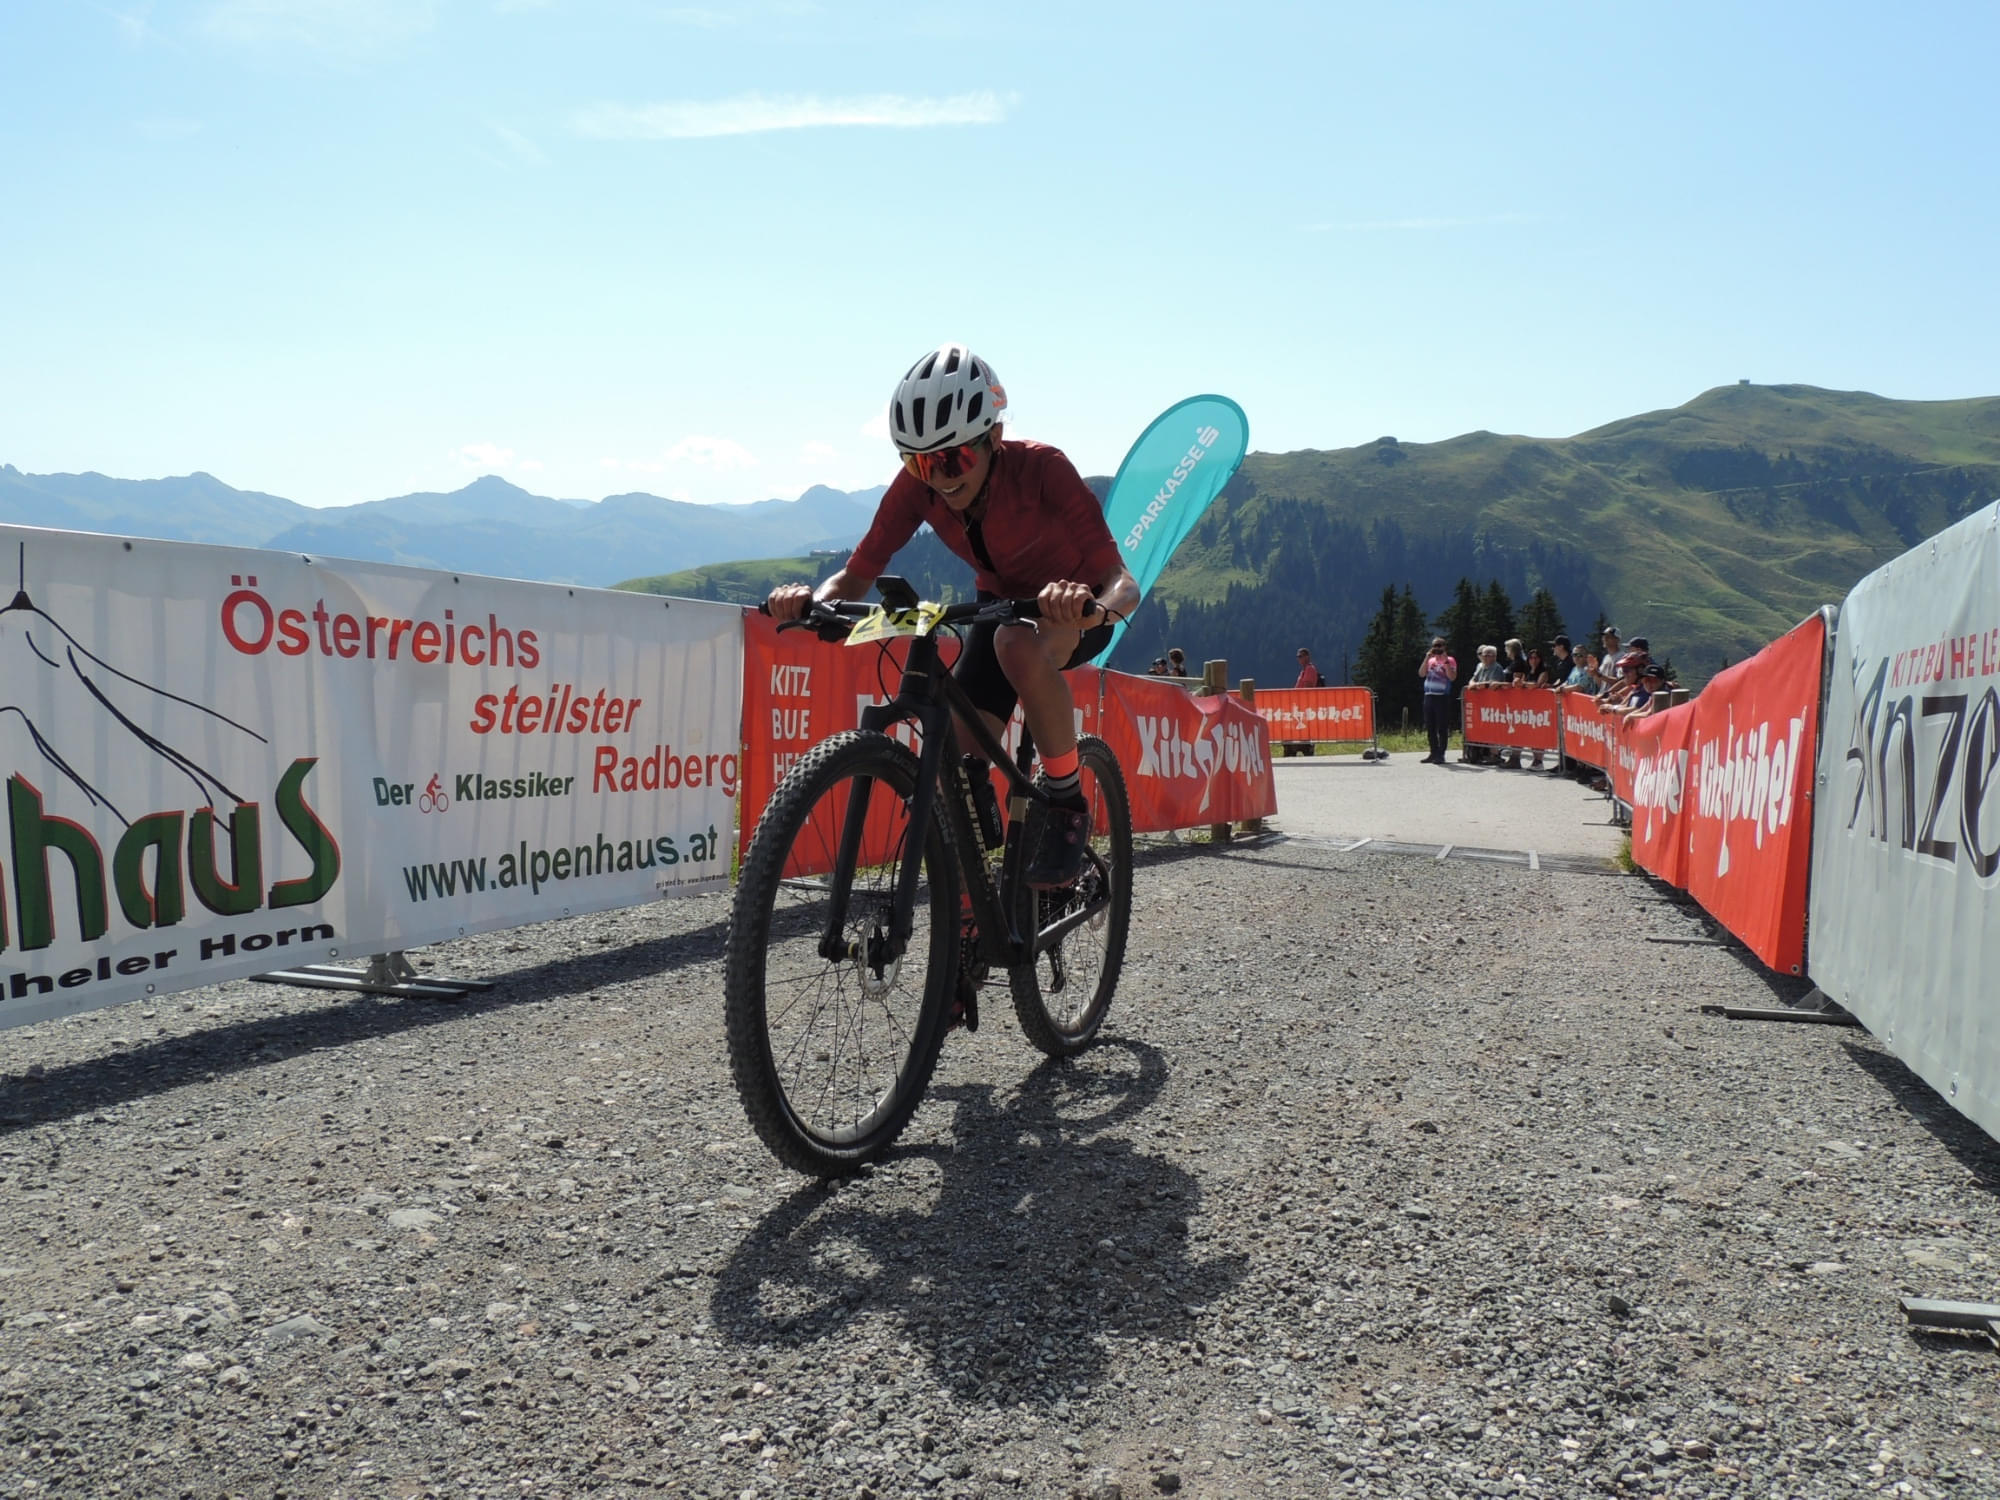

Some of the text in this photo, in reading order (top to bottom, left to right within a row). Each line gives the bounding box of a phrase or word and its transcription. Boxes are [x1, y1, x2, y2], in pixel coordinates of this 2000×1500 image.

[1124, 444, 1205, 551] SPARKASSE
[221, 575, 540, 669] Österreichs
[771, 664, 811, 697] KITZ
[1891, 629, 2000, 688] KITZBÜHELE
[470, 684, 641, 734] steilster
[772, 708, 810, 740] BUE
[1480, 706, 1550, 730] Kitzbühel
[373, 772, 574, 806] Der Klassiker
[593, 745, 738, 797] Radberg
[1701, 712, 1802, 862] Kitzbühel
[0, 757, 341, 953] haus
[403, 824, 718, 902] www.alpenhaus.at
[0, 923, 334, 1000] heler Horn
